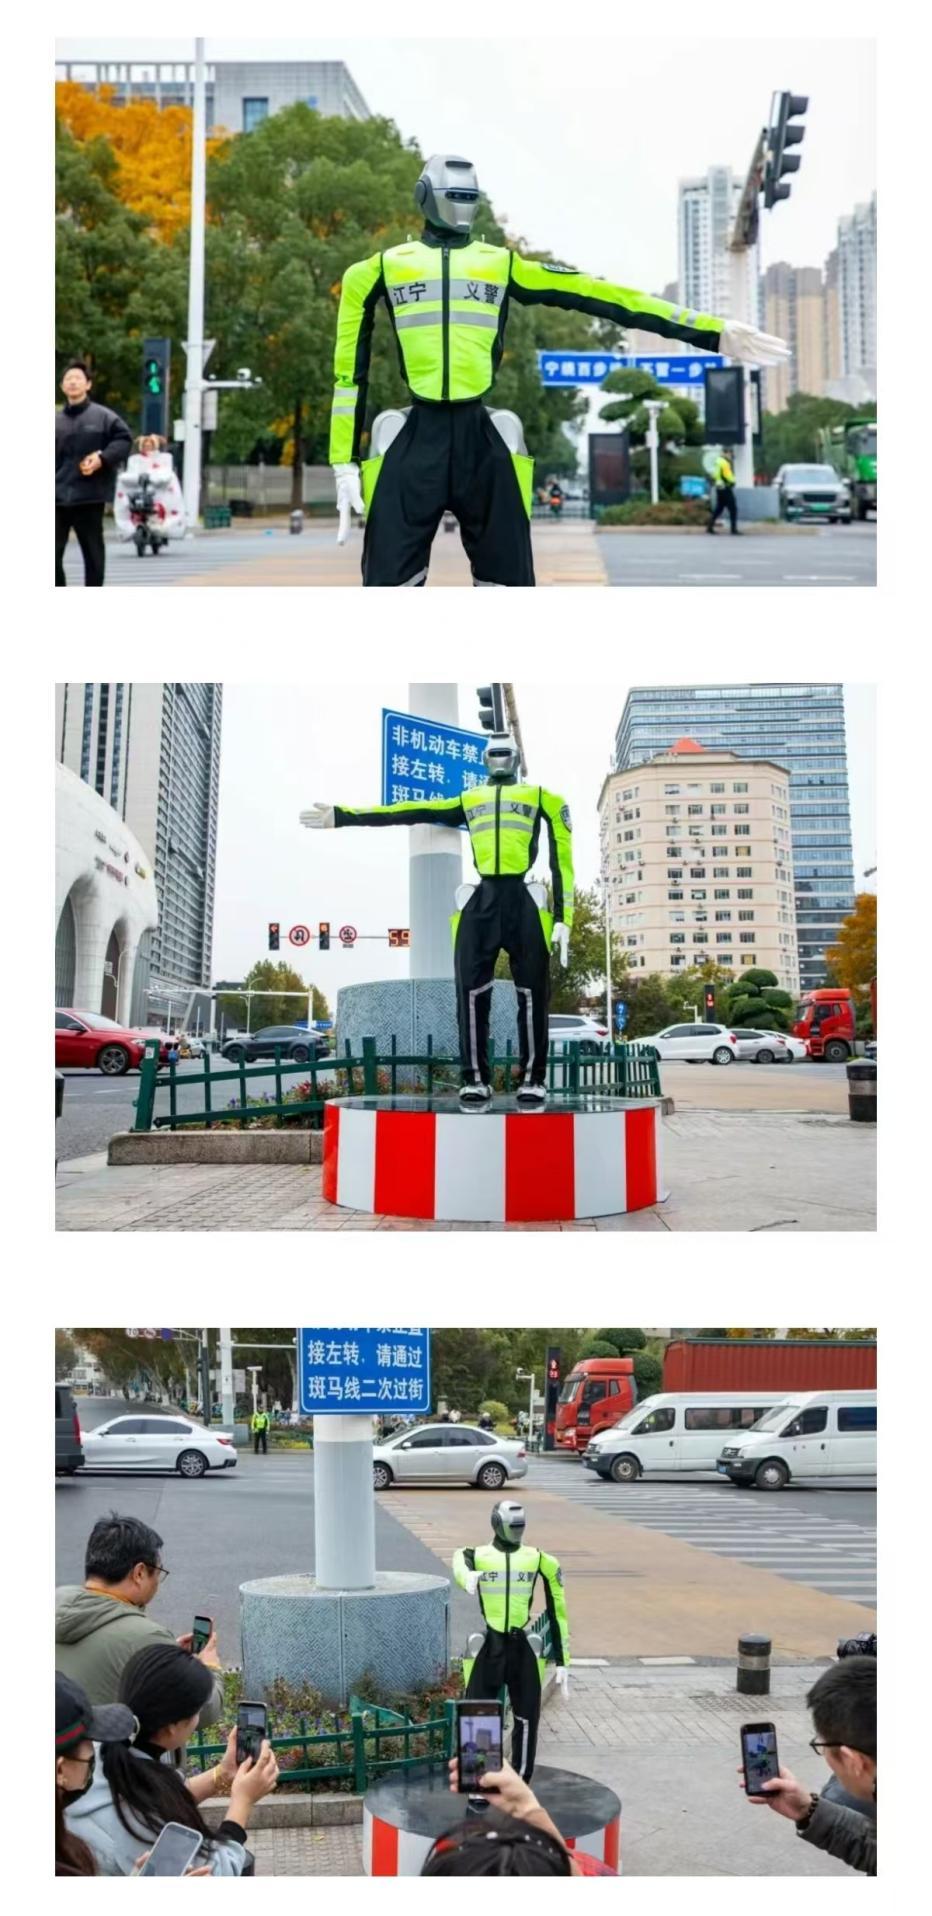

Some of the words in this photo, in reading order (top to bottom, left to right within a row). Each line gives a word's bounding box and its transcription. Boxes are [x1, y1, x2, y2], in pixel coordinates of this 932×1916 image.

[393, 282, 426, 305] 江宁
[464, 281, 499, 304] 义警
[389, 930, 411, 946] 59
[308, 1375, 424, 1401] 斑马线二次过街
